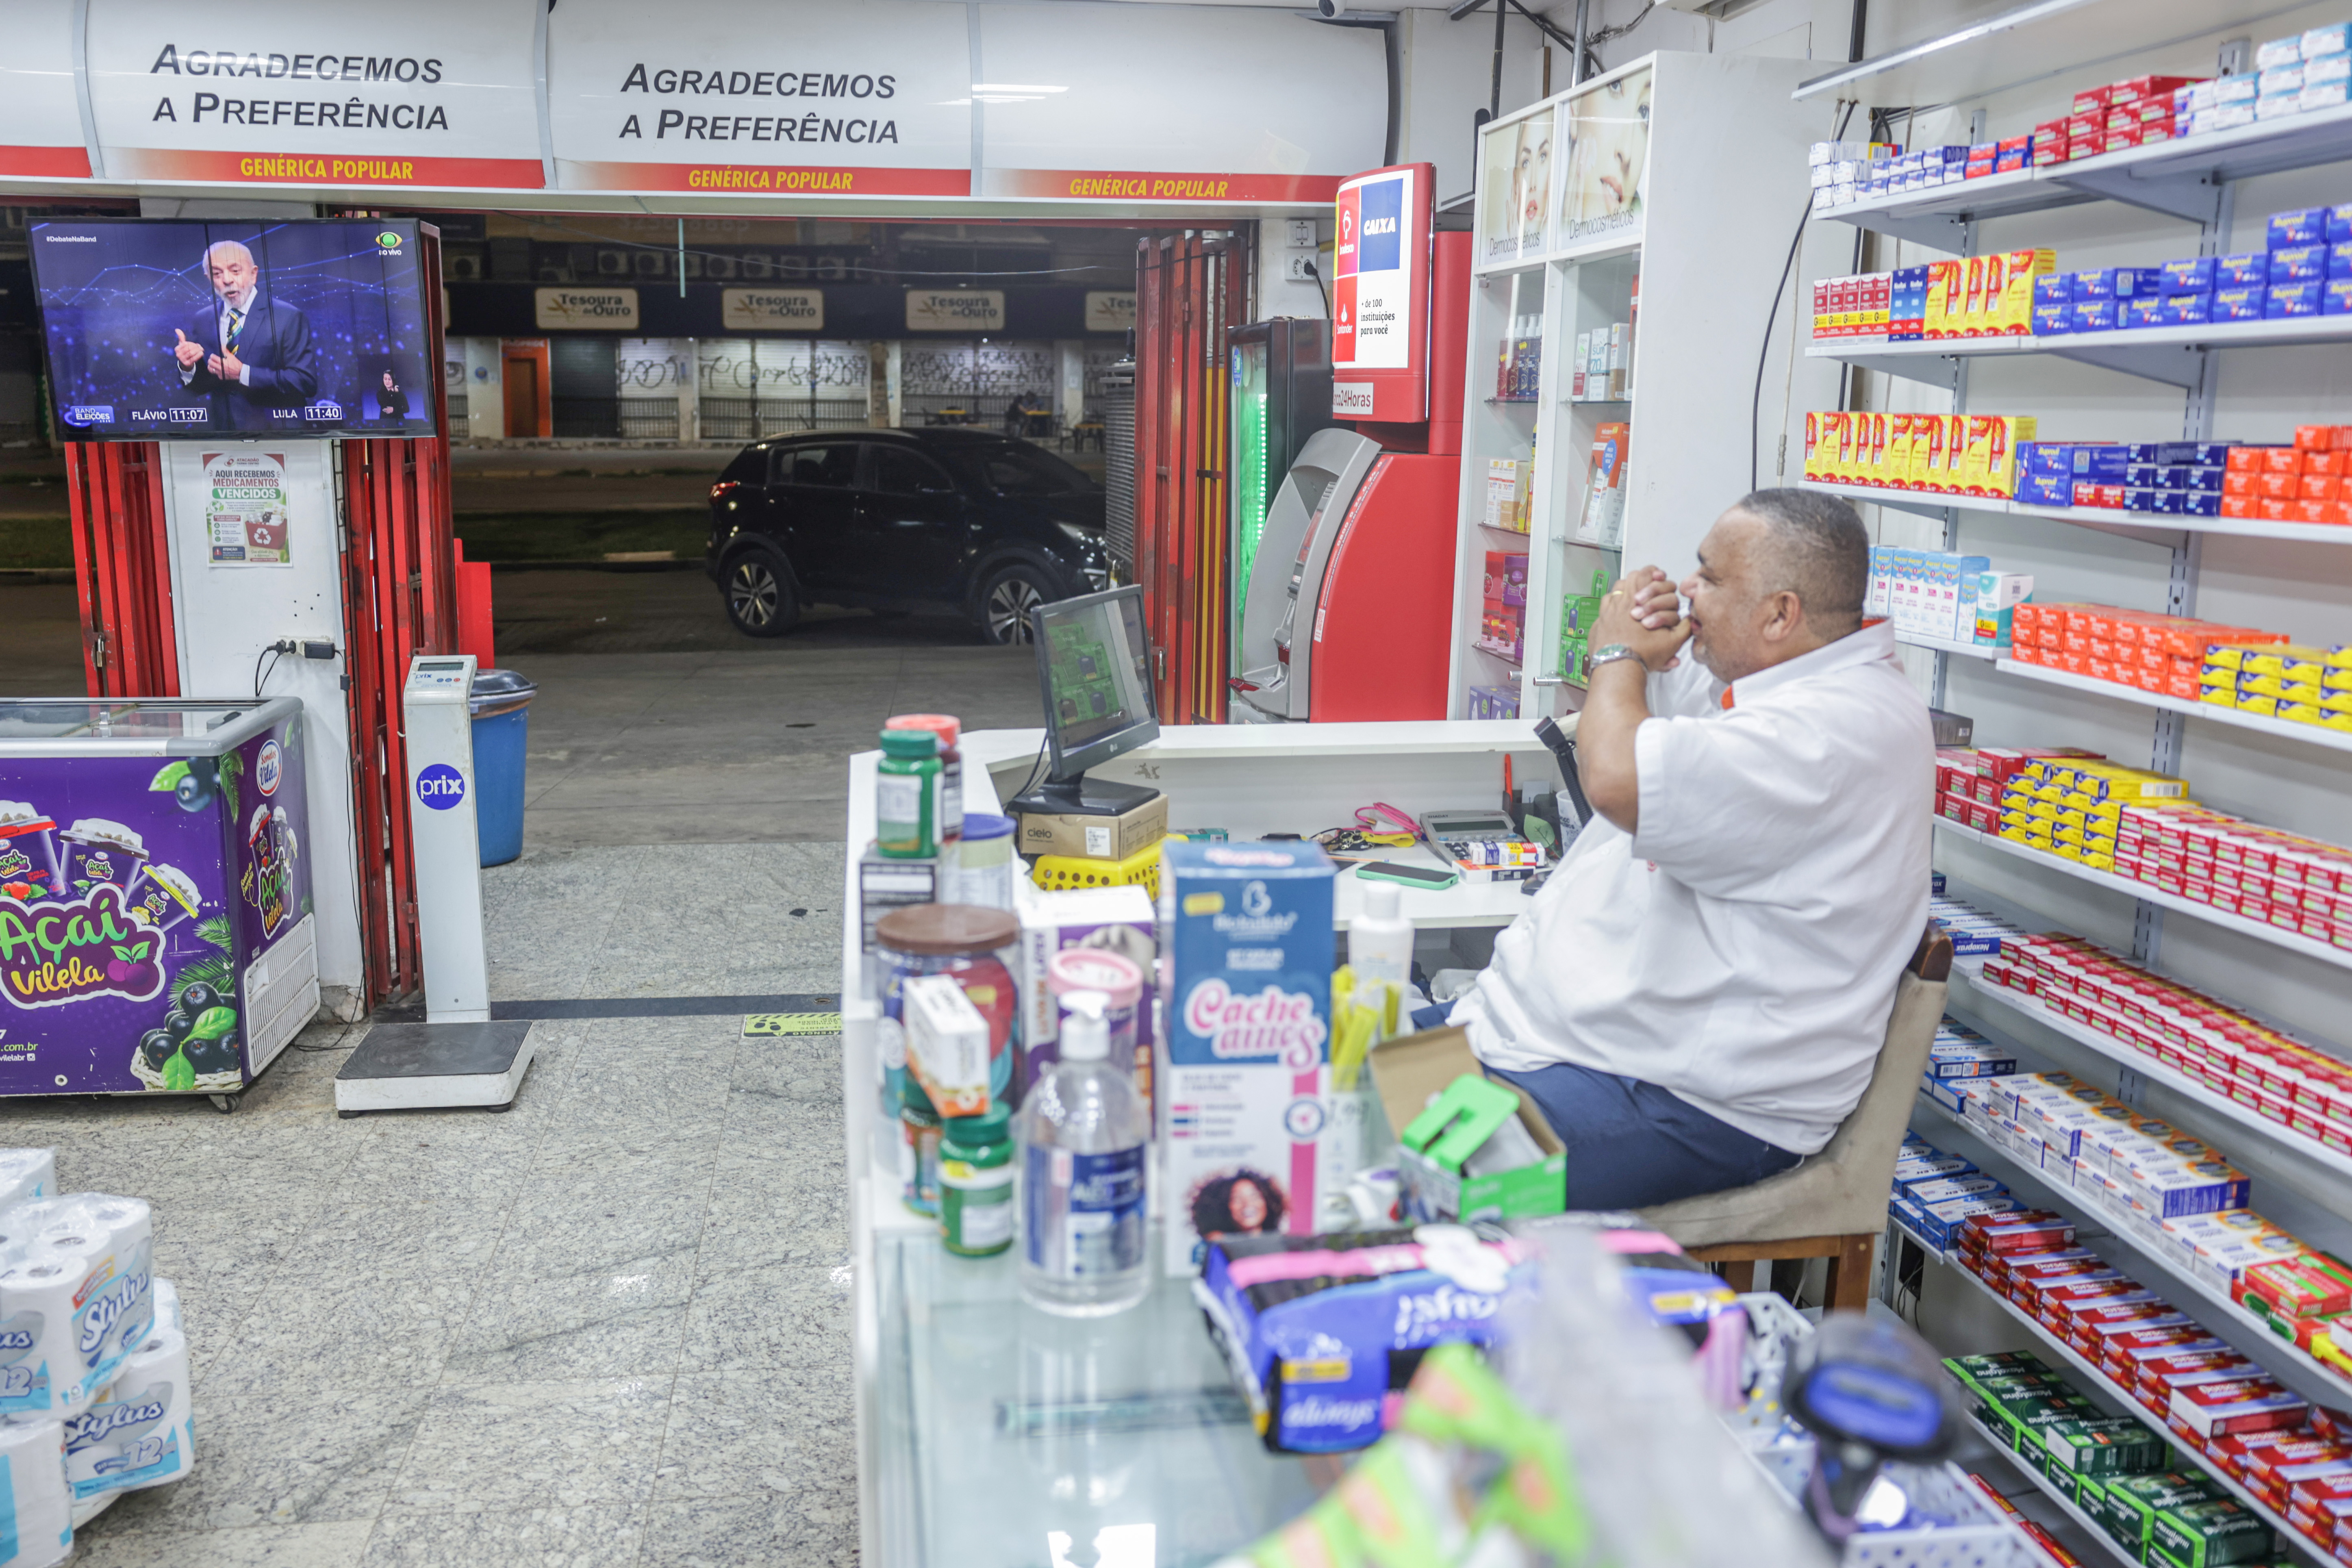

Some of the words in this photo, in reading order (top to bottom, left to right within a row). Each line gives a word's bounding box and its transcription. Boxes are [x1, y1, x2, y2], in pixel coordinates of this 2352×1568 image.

[150, 43, 443, 84] AGRADECEMOS
[621, 63, 896, 99] AGRADECEMOS
[193, 92, 449, 130] PREFERÊNCIA
[656, 109, 899, 144] PREFERÊNCIA
[240, 153, 328, 179] GENÉRICA
[333, 160, 413, 180] POPULAR
[688, 166, 770, 189] GENÉRICA
[775, 171, 853, 190] POPULAR
[1069, 174, 1147, 197] GENÉRICA
[1152, 179, 1228, 198] POPULAR
[1364, 217, 1396, 236] CAIXA
[1569, 208, 1634, 240] Dermocosméticos
[46, 235, 97, 243] #DebateNaBand
[1490, 231, 1540, 257] Dermocosméticos
[1339, 244, 1354, 256] bradesco
[559, 294, 623, 306] Tesoura
[746, 295, 809, 306] Tesoura
[929, 296, 990, 308] Tesoura
[1365, 299, 1371, 308] de
[1373, 298, 1382, 307] 100
[593, 305, 631, 317] Ouro
[779, 305, 817, 317] Ouro
[961, 306, 997, 318] Ouro
[1361, 311, 1395, 324] instituições
[1337, 324, 1353, 334] Santander
[1361, 327, 1372, 337] para
[1374, 324, 1388, 334] você
[1333, 389, 1371, 407] anco24Horas
[76, 411, 110, 421] ELEIÇÕES
[132, 410, 167, 421] FLÁVIO
[172, 410, 204, 420] 11:07
[273, 409, 298, 419] LULA
[308, 408, 339, 418] 11:40
[213, 478, 279, 487] MEDICAMENTOS
[217, 489, 276, 498] VENCIDOS
[1337, 522, 1349, 546] 0800
[1354, 495, 1362, 508] 24
[1368, 471, 1377, 482] 24
[261, 749, 276, 764] Sorvetes
[259, 760, 278, 784] Vilela
[420, 775, 463, 799] prix
[1027, 827, 1052, 839] cielo
[261, 864, 286, 909] Açaí
[265, 897, 283, 931] Vilela
[0, 897, 128, 966] Açaí
[1956, 943, 1990, 951] Nexoprax
[10, 962, 105, 997] Vilela
[2034, 1260, 2082, 1270] Dorsanol
[1282, 1392, 1375, 1429] always
[122, 1437, 163, 1472] 12
